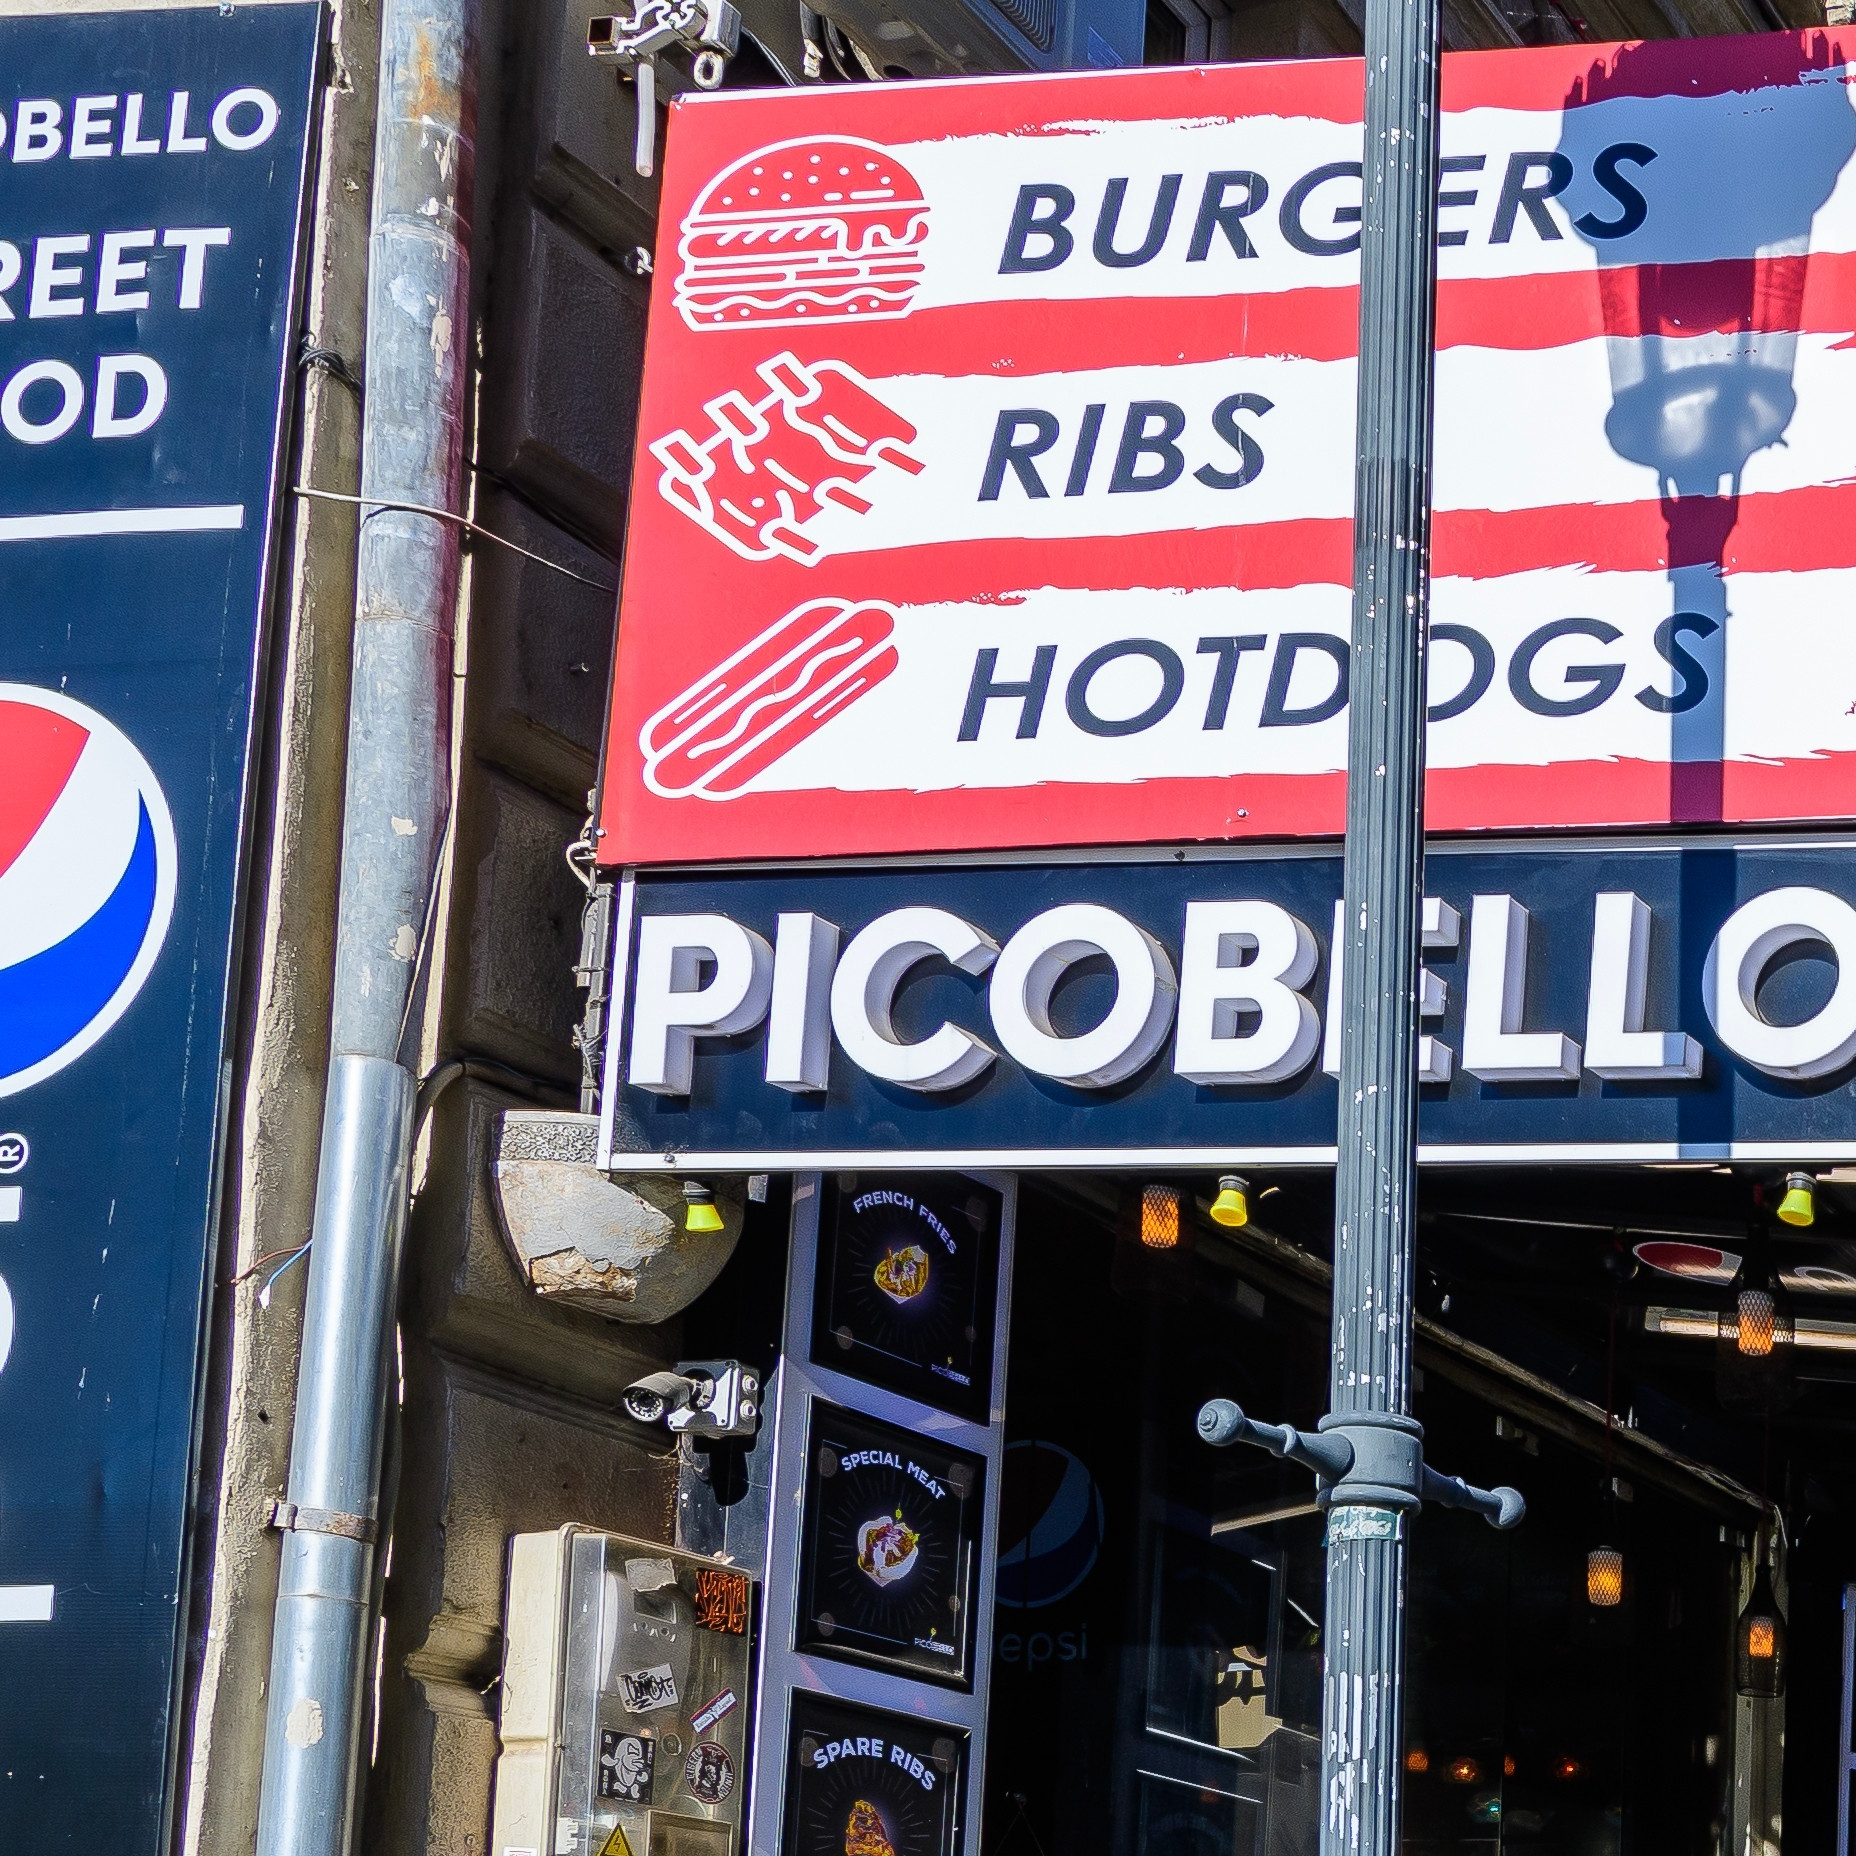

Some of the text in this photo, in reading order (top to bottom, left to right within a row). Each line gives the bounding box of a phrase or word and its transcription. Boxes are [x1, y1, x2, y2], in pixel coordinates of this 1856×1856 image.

[998, 141, 1660, 276] BURGERS
[977, 391, 1276, 501] RIBS
[956, 612, 1726, 743] HOTDOGS
[853, 1191, 958, 1255] FRENCH FRIES
[841, 1450, 946, 1501] SPECIAL MEAT
[813, 1737, 937, 1791] SPARE RIBS
